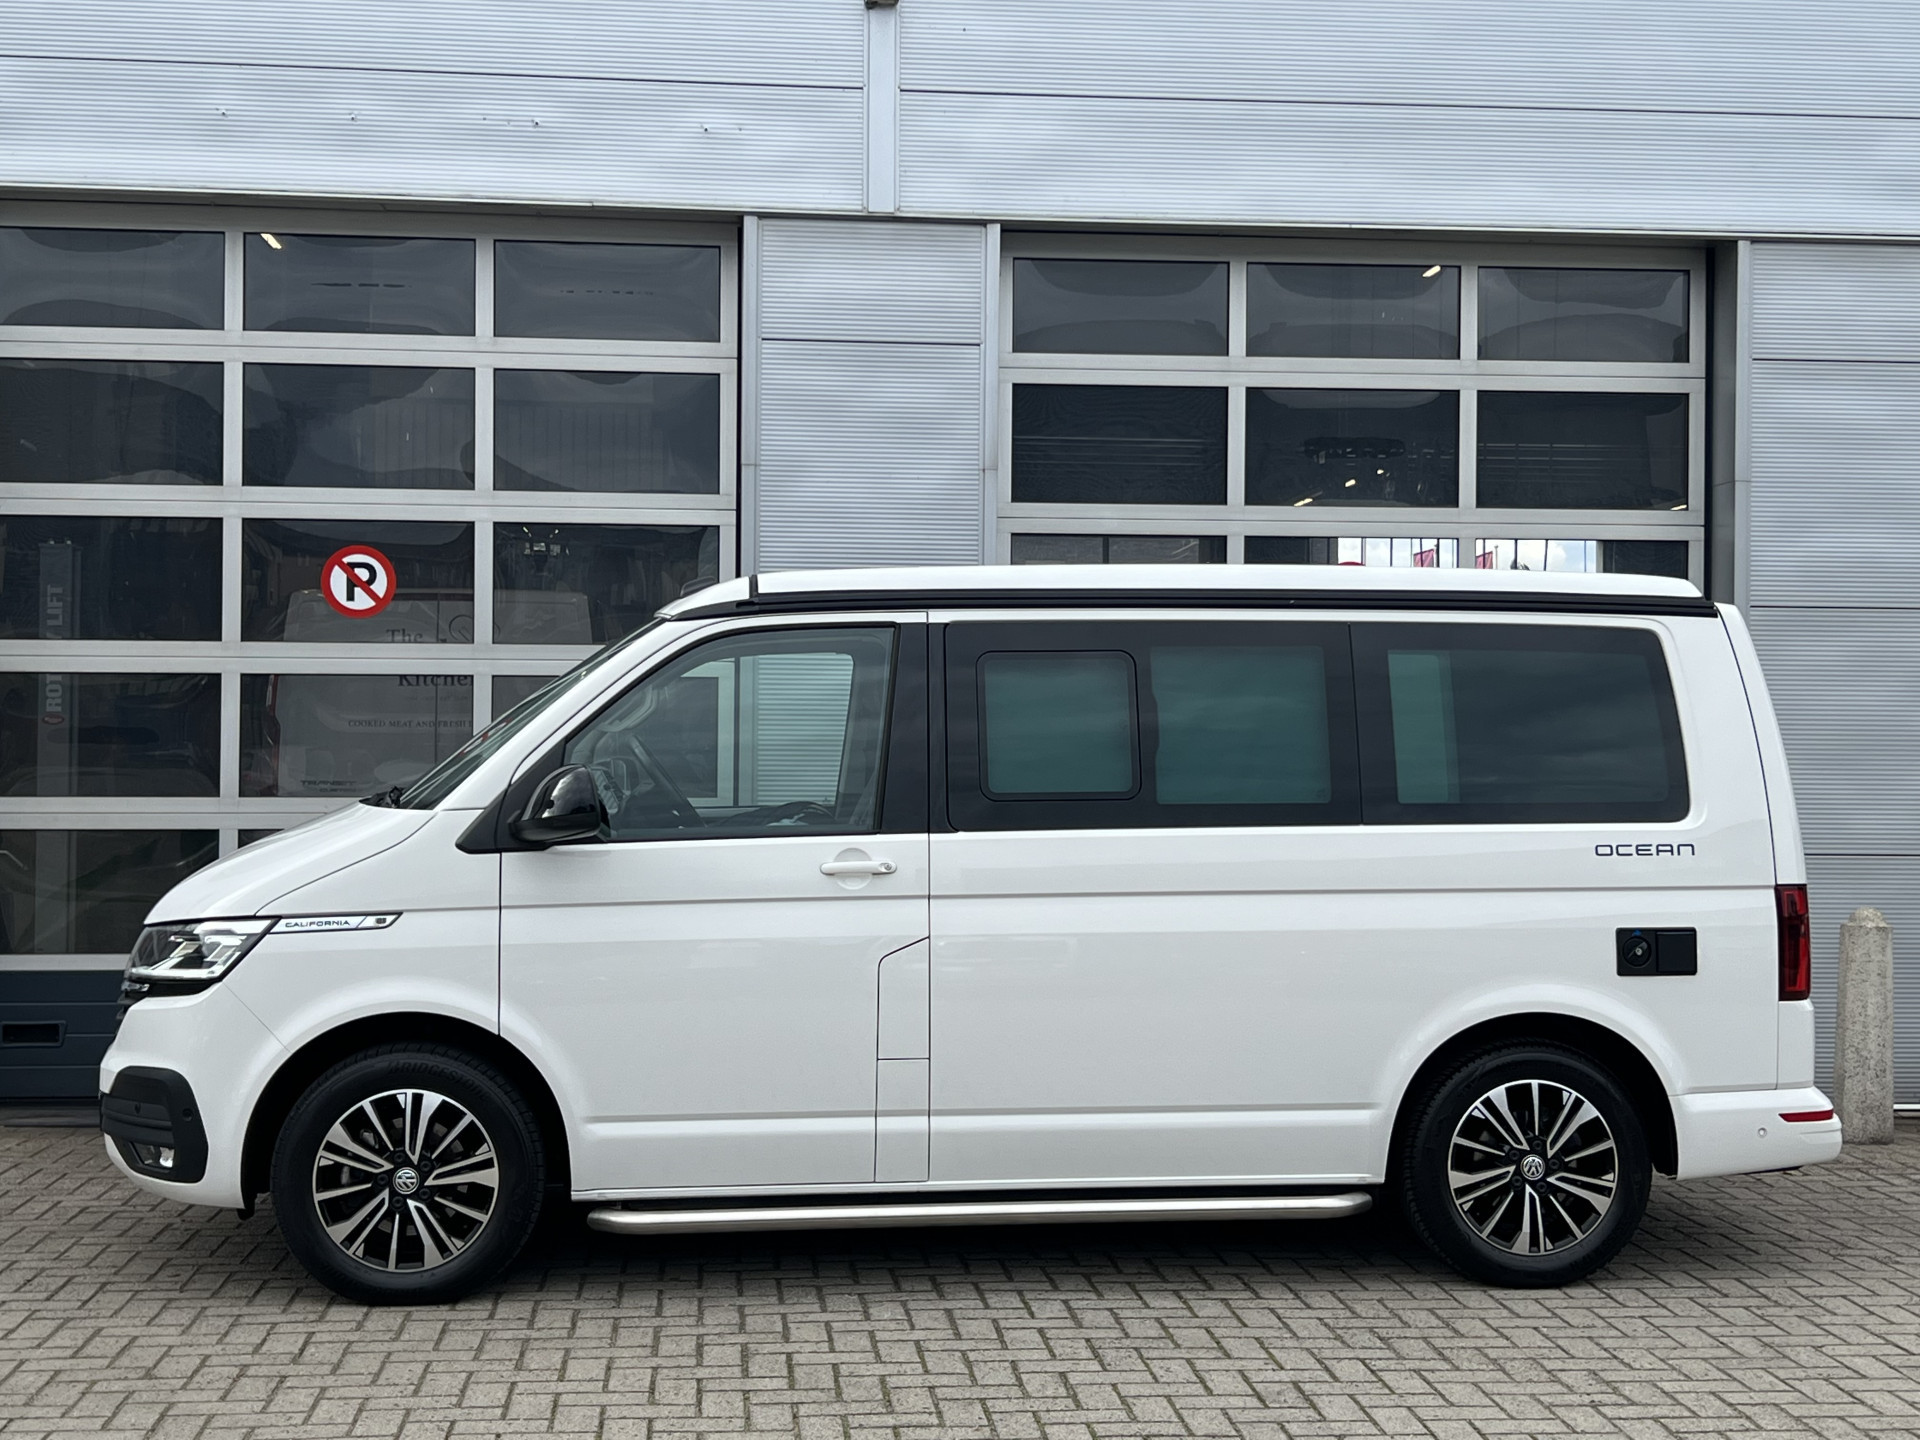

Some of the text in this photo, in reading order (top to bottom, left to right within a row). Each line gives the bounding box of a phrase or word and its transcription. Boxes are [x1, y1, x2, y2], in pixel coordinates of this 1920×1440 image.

[346, 562, 377, 602] P
[46, 584, 63, 626] LIFT
[397, 675, 474, 687] Kitche
[348, 719, 386, 728] COOKED
[388, 719, 412, 728] MEAT
[415, 719, 436, 728] AND
[1595, 843, 1695, 856] OCEAN
[285, 919, 350, 928] CALIFORNIA
